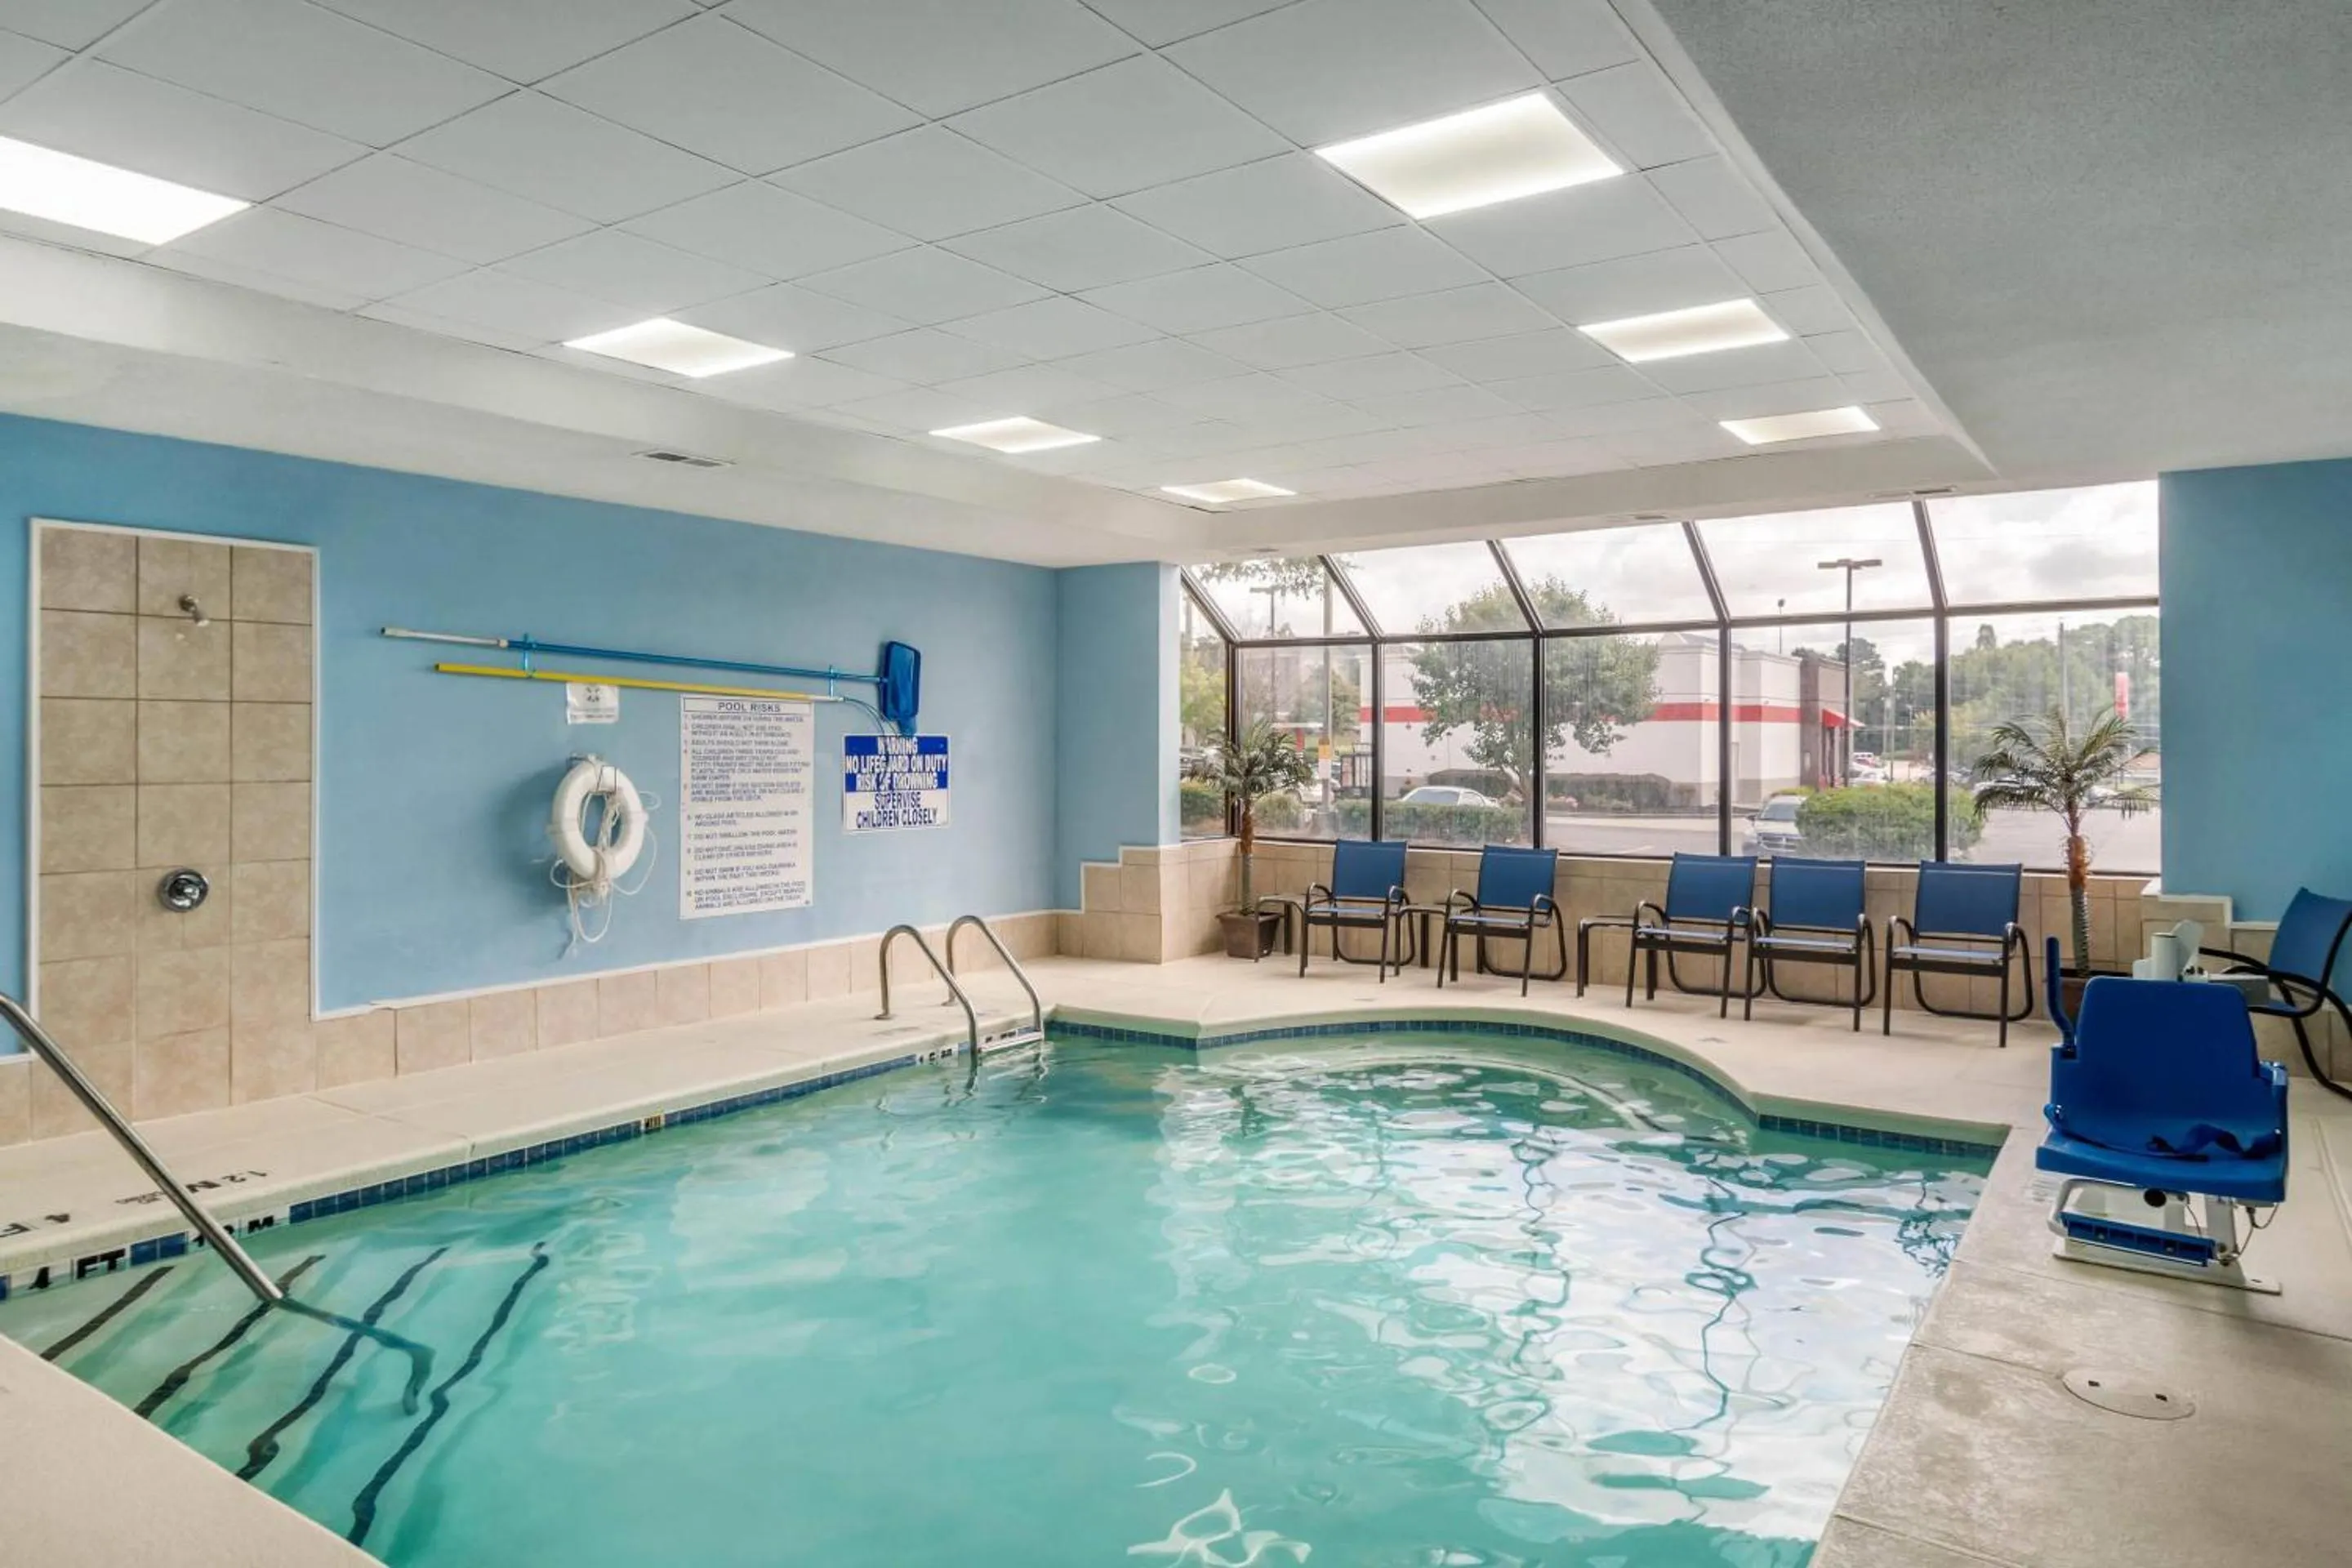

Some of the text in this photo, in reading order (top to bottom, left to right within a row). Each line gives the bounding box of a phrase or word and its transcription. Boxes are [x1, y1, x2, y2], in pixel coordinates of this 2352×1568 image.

[718, 702, 746, 711] POOL
[877, 737, 918, 755] WARNING
[846, 755, 859, 773] NO
[911, 755, 924, 773] ON
[924, 754, 947, 773] DUTY
[856, 773, 877, 791] RISK
[893, 772, 938, 790] DROWNING
[874, 791, 921, 809] SUPERVISE
[856, 808, 938, 828] CHILDREN CLOSELY
[77, 1247, 126, 1280] FT
